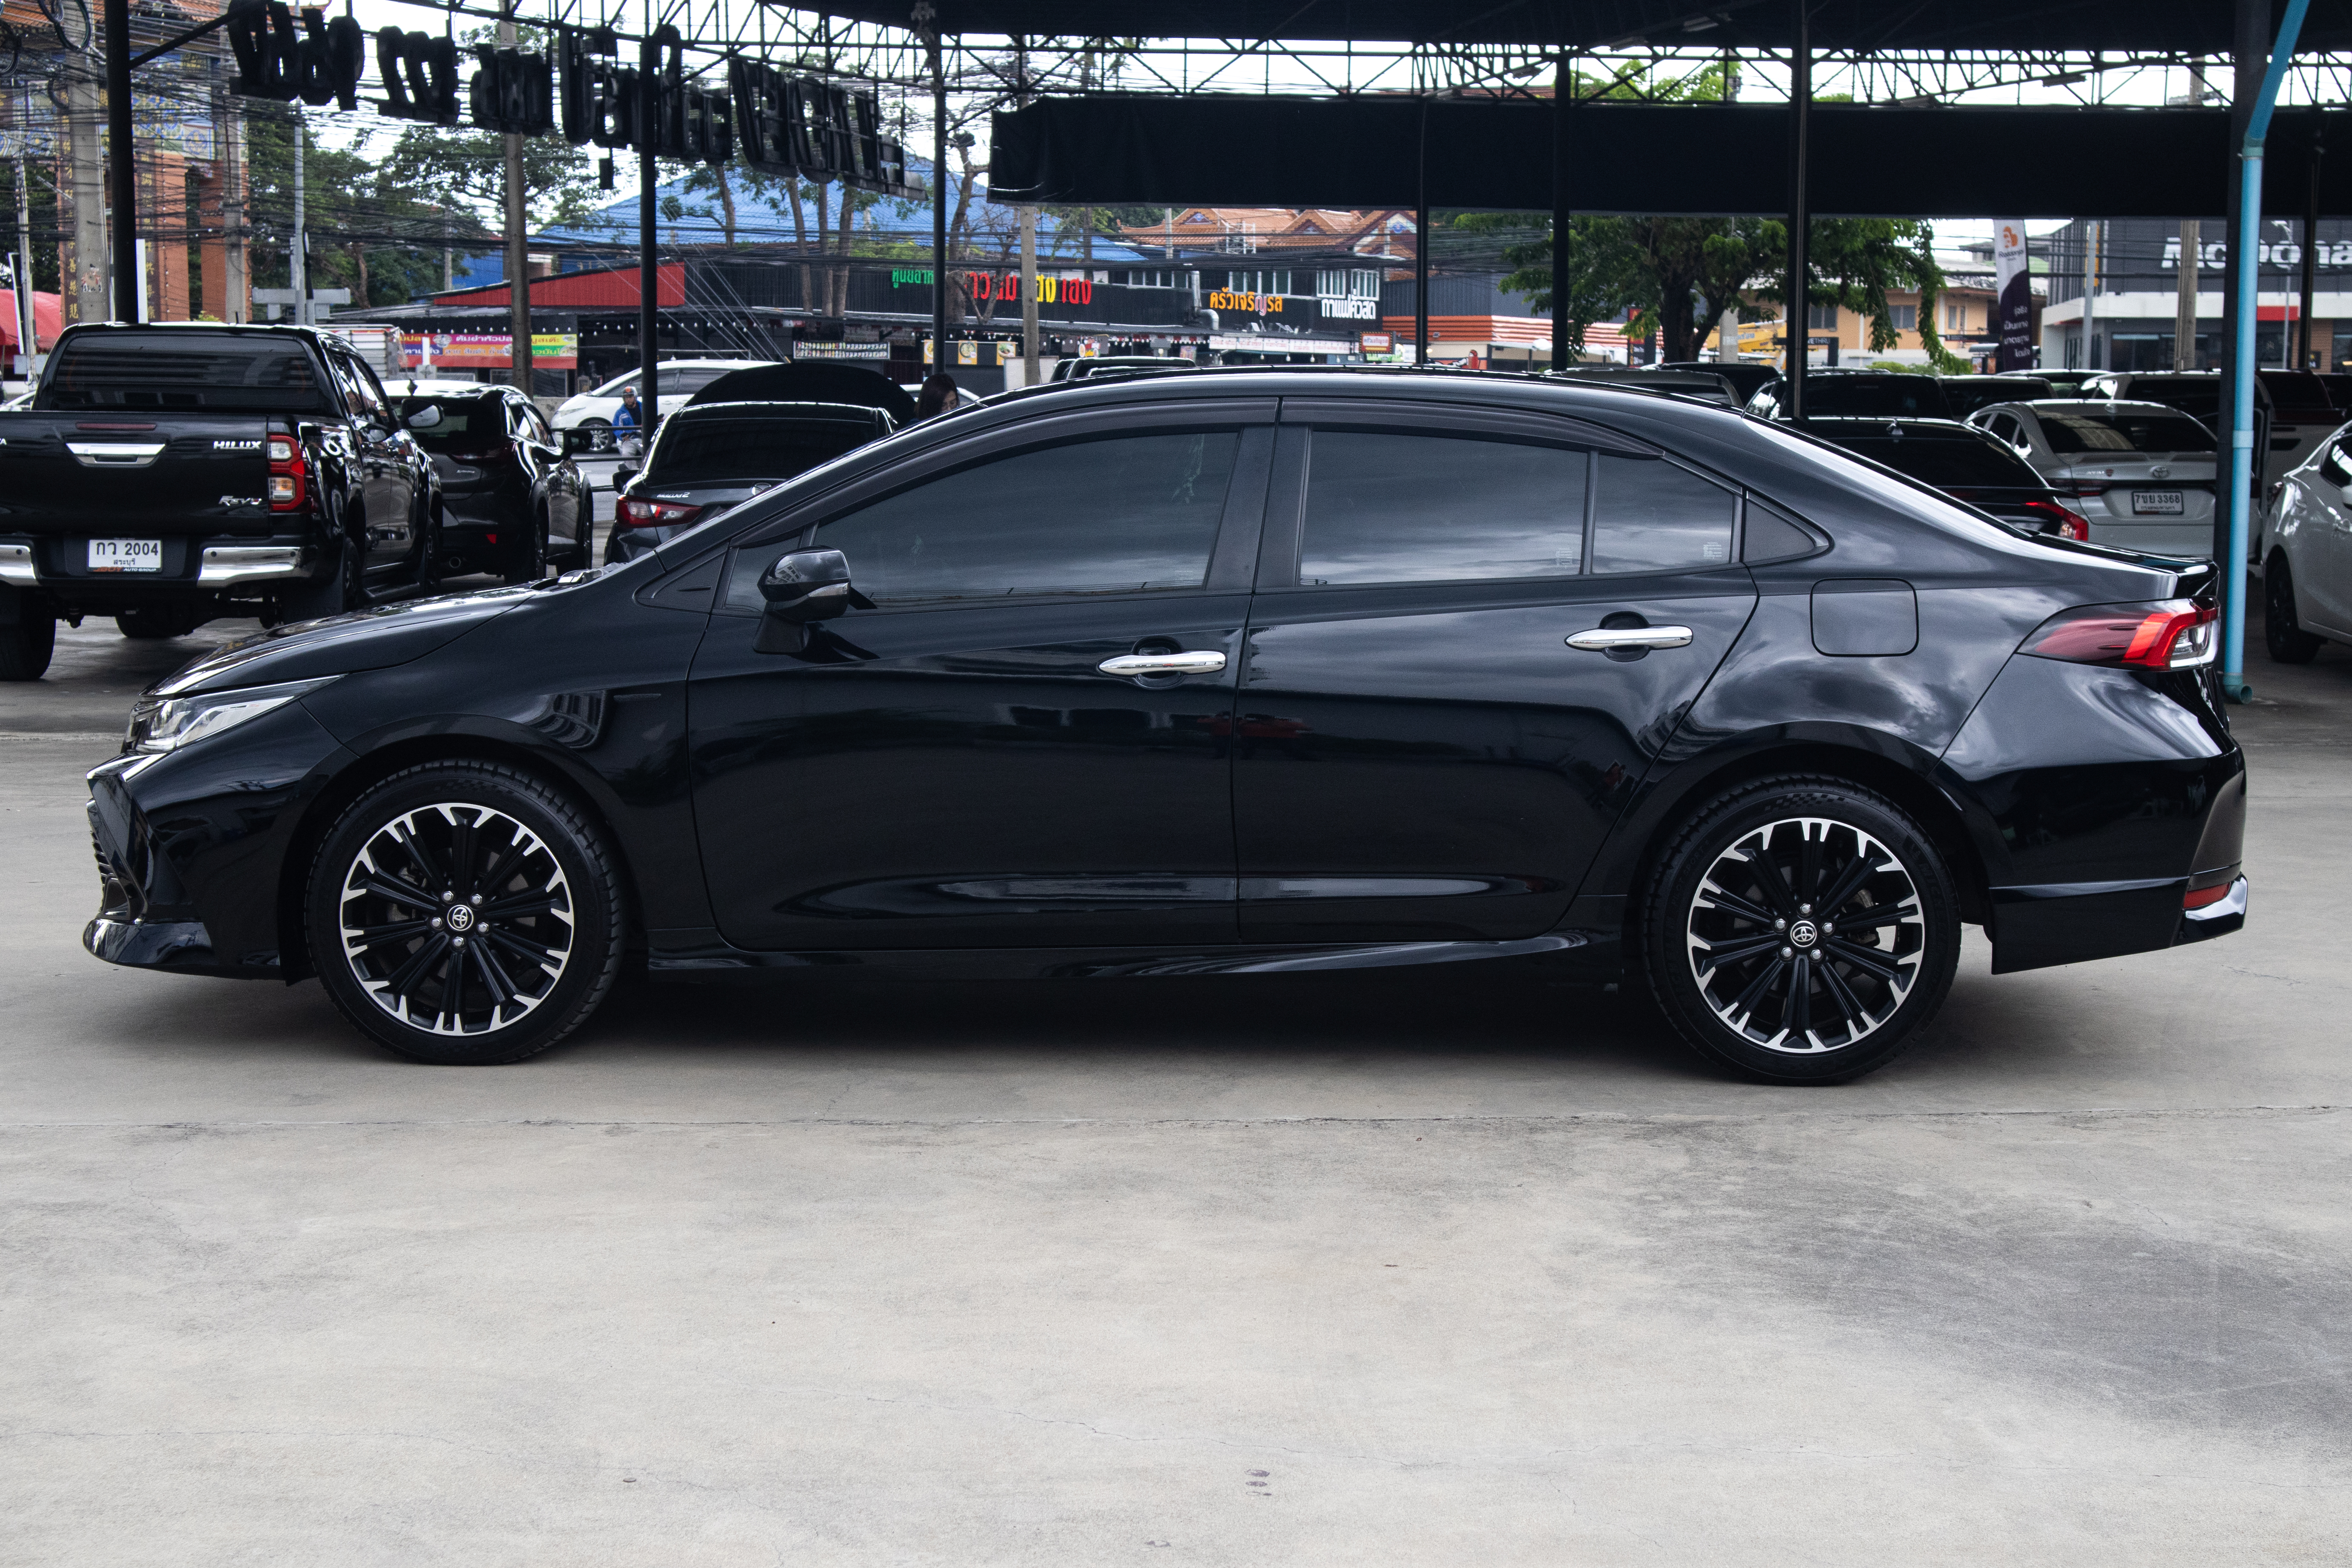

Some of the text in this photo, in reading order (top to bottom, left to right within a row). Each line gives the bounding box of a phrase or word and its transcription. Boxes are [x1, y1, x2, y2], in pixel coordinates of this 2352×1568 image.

[1210, 287, 1283, 316] ครัวเจริญรส
[214, 441, 262, 450] HILUX
[2157, 494, 2180, 503] 3368
[96, 542, 158, 556] กว 2004
[114, 558, 136, 567] สระบุรี
